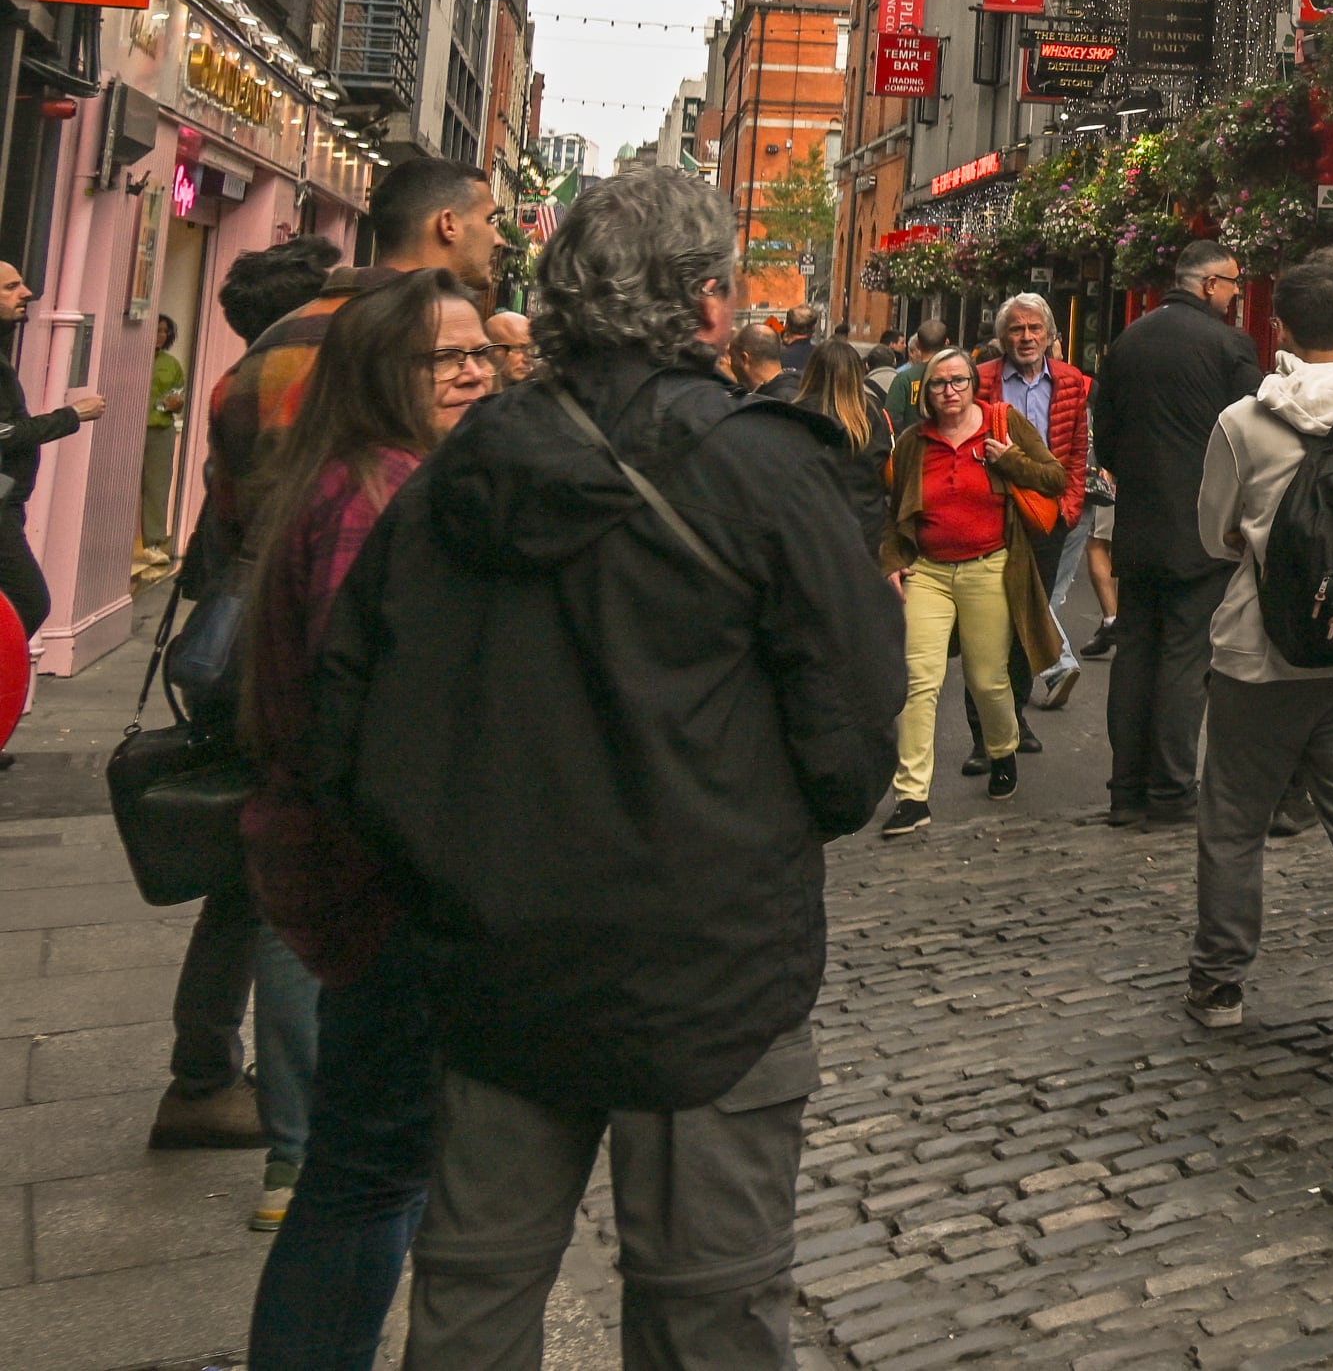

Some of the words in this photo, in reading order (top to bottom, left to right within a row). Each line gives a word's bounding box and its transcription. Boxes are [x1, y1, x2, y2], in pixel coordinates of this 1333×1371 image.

[1034, 31, 1056, 41] THE
[1057, 32, 1098, 43] TEMPLE
[1100, 35, 1121, 45] BAR
[1137, 30, 1164, 40] LIVE
[1167, 32, 1204, 42] MUSIC
[896, 38, 920, 49] THE
[1152, 43, 1189, 53] DAILY
[884, 48, 932, 61] TEMPLE
[1041, 43, 1088, 59] WHISKEY
[1087, 46, 1114, 60] SHOP
[893, 60, 919, 72] BAR
[1047, 62, 1107, 73] DISTILLERY
[889, 76, 924, 85] TRADING
[1060, 78, 1094, 88] STORE
[884, 84, 925, 94] COMPANY
